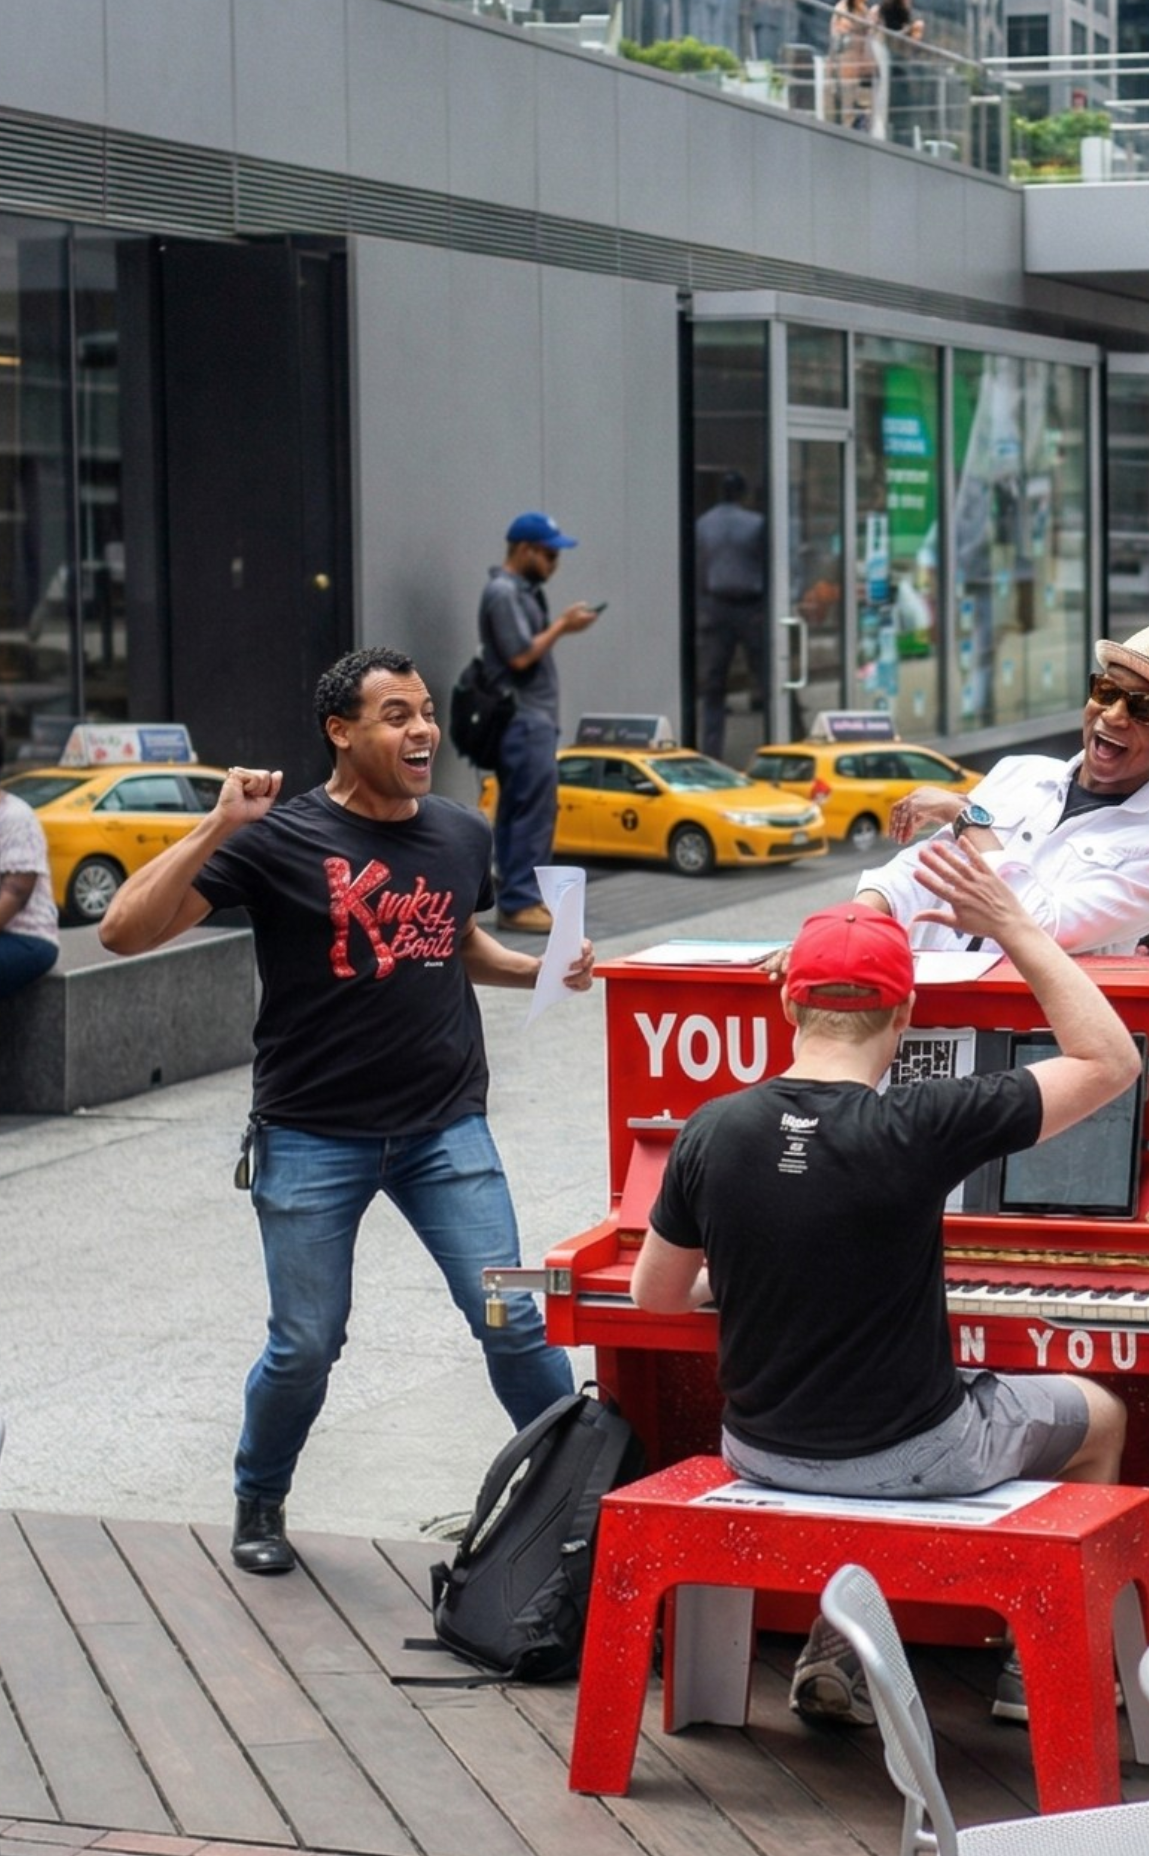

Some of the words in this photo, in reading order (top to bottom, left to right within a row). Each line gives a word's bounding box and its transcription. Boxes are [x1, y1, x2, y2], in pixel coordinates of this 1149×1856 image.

[633, 1012, 768, 1084] YOU
[959, 1325, 985, 1363] N
[1027, 1327, 1138, 1371] YOU
